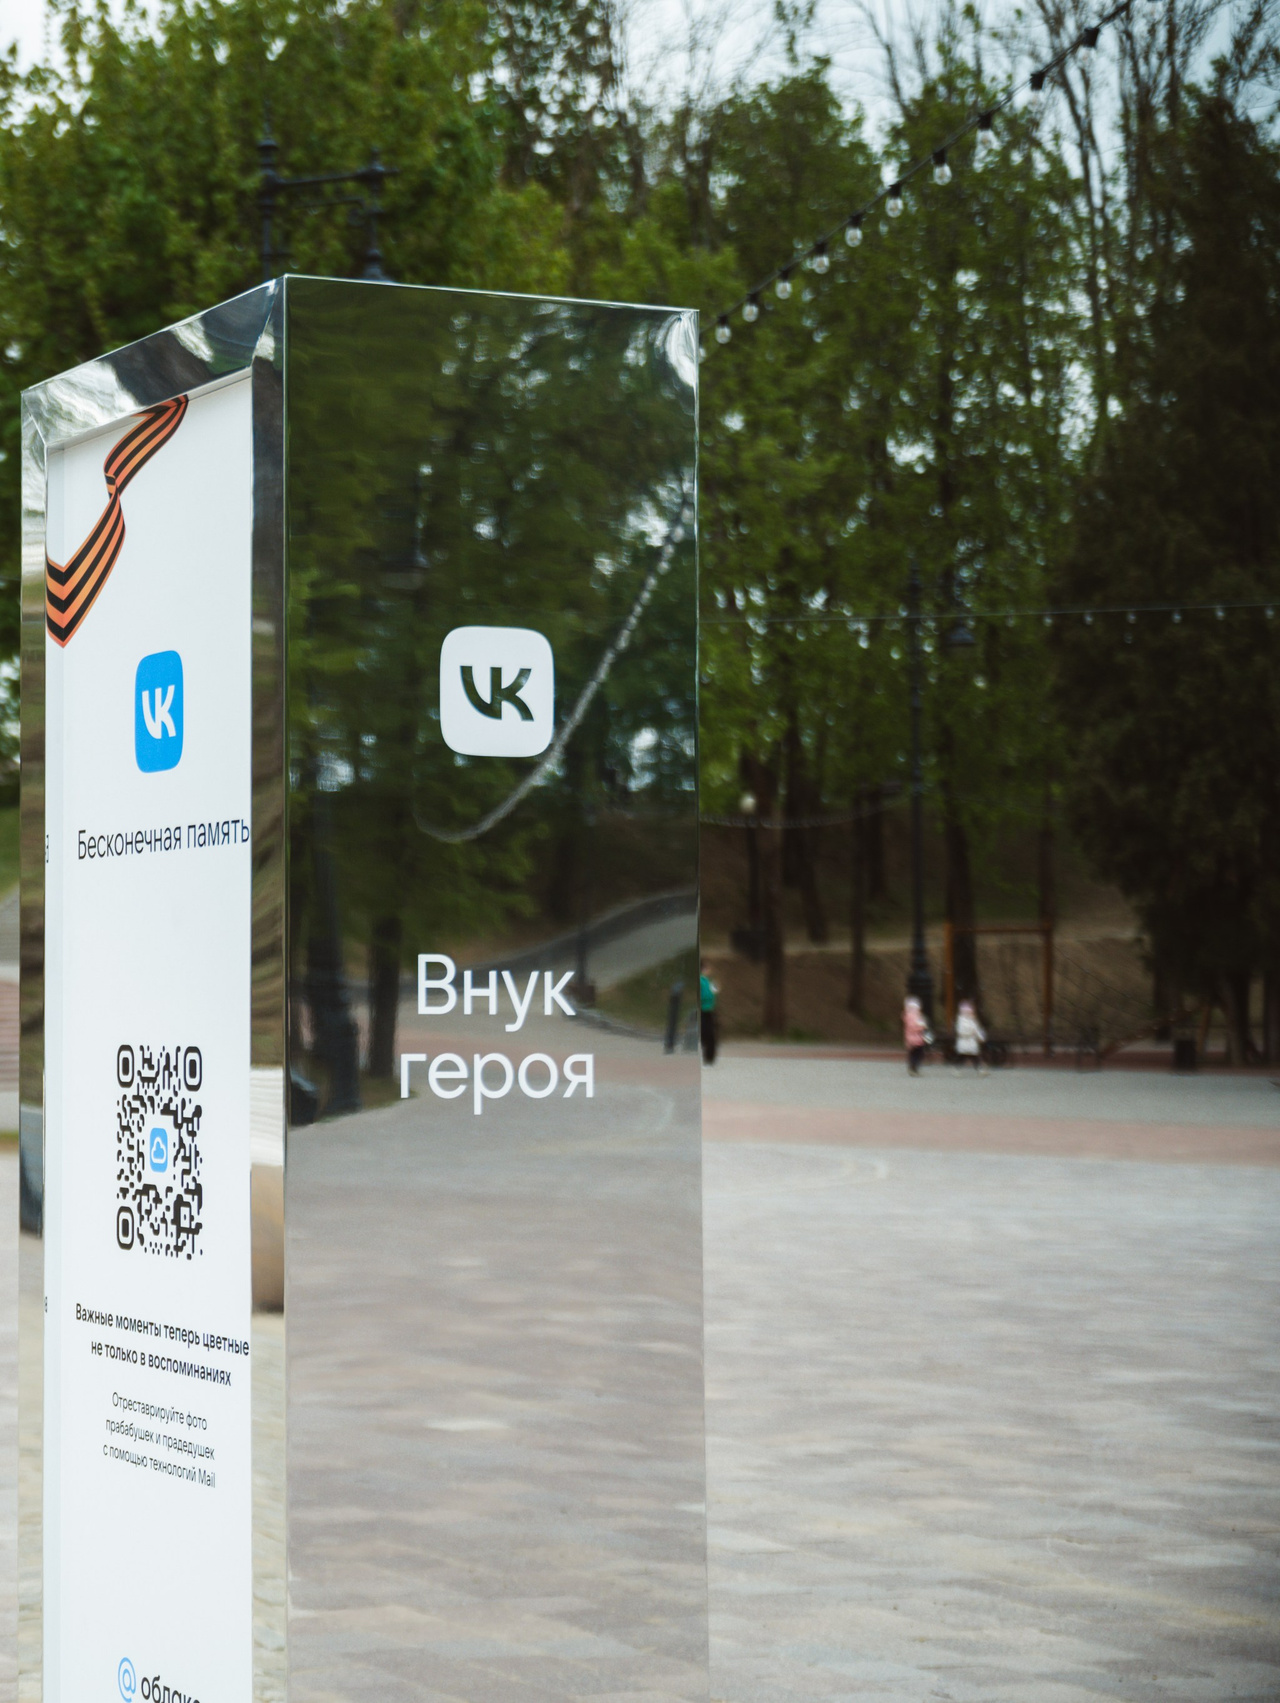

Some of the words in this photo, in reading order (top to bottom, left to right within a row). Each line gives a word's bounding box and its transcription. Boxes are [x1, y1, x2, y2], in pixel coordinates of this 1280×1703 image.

[142, 685, 176, 739] VK
[460, 666, 534, 721] VK
[78, 826, 181, 860] Бесконечная
[188, 819, 249, 848] память
[418, 955, 575, 1031] Внук
[401, 1053, 594, 1115] героя
[76, 1303, 113, 1327] Важные
[116, 1315, 161, 1337] моменты
[164, 1325, 200, 1348] теперь
[203, 1333, 249, 1356] цветные
[91, 1341, 103, 1357] не
[105, 1344, 137, 1364] только
[140, 1351, 146, 1367] в
[149, 1354, 231, 1386] воспоминаниях
[112, 1391, 185, 1425] Отреставрируйте
[186, 1413, 208, 1431] фото
[105, 1419, 154, 1442] прабабушек
[155, 1433, 161, 1444] и
[162, 1434, 215, 1460] прадедушек
[103, 1444, 108, 1456] с
[109, 1446, 148, 1468] помощью
[148, 1457, 197, 1482] технологий
[198, 1468, 216, 1487] Mail
[141, 1675, 200, 1703] обла
